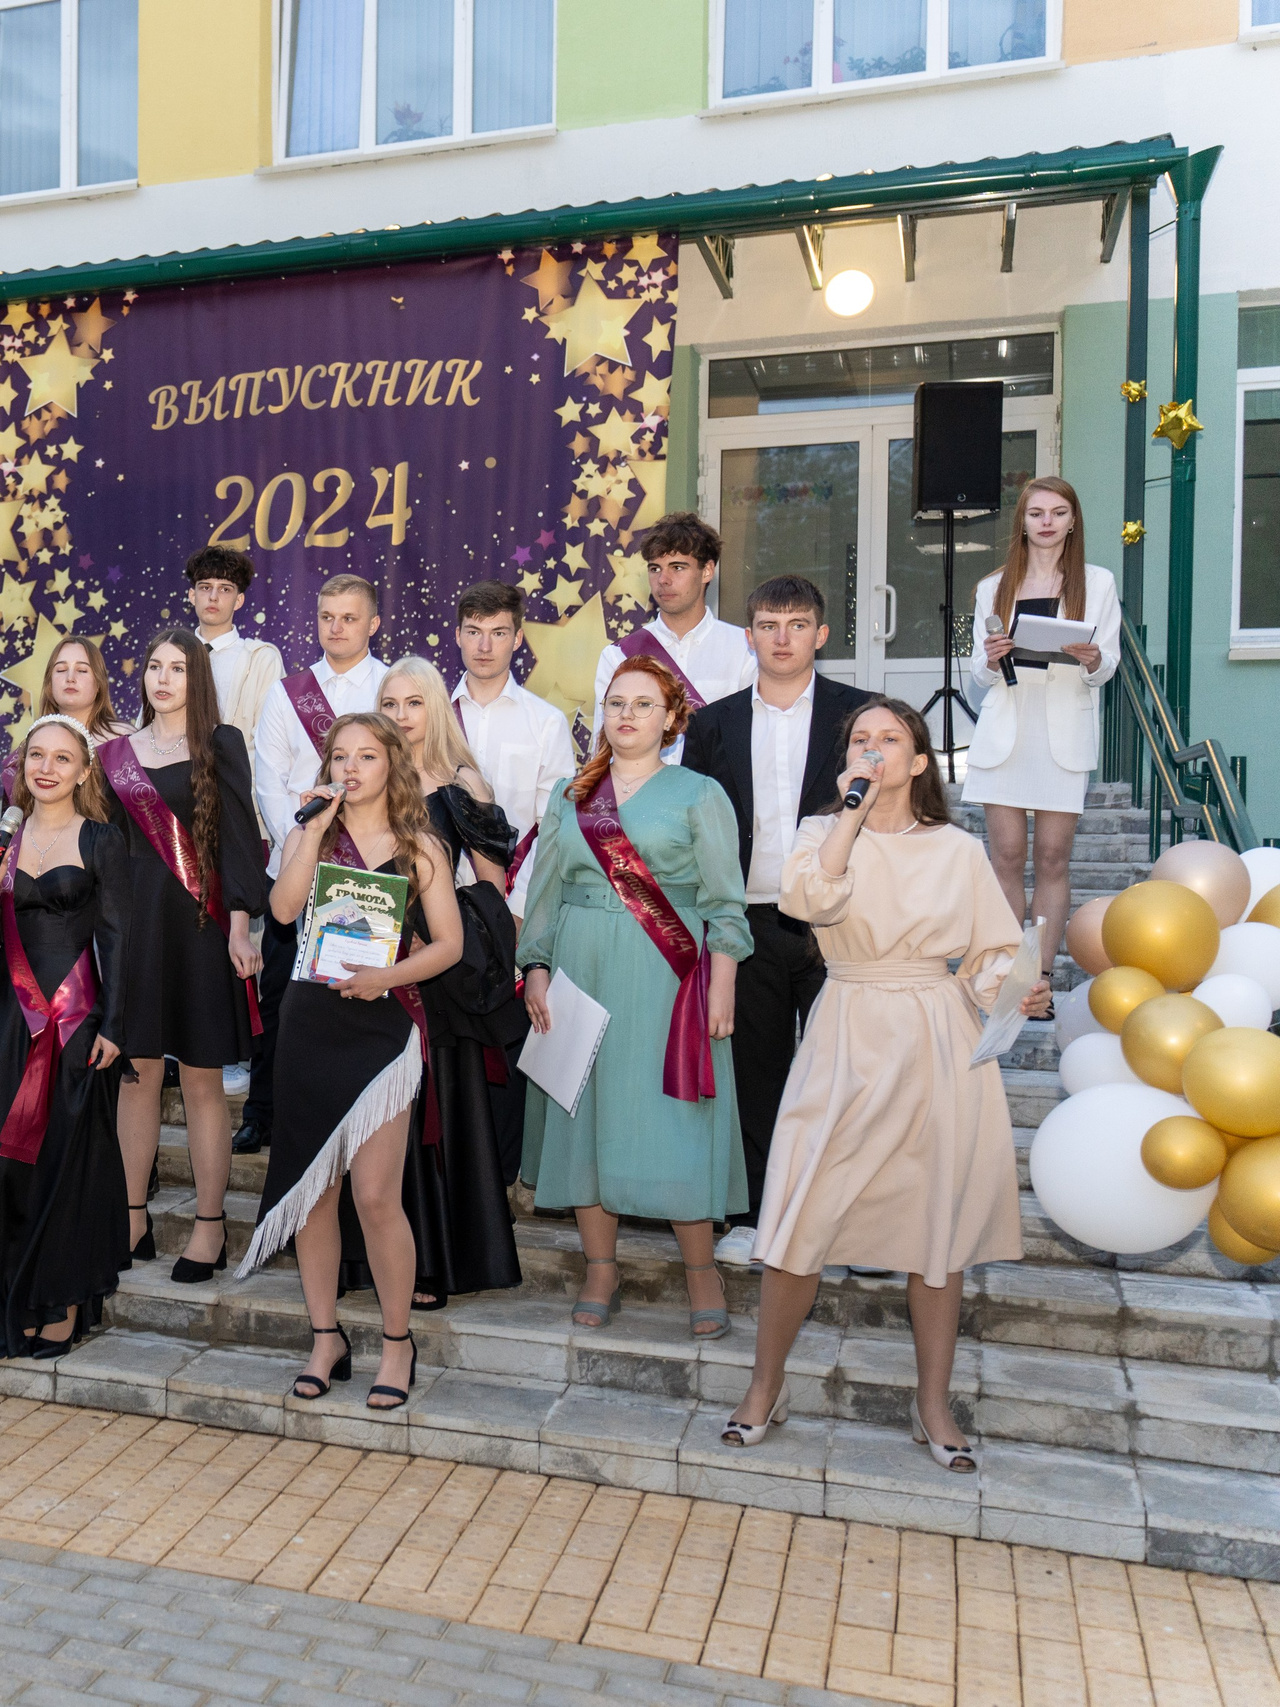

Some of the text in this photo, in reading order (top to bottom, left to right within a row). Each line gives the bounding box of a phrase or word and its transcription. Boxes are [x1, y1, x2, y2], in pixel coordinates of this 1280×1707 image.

[148, 358, 484, 431] ВЫПУСКНИК
[207, 461, 412, 552] 2024
[335, 888, 388, 906] ГРАМОТА
[653, 914, 694, 951] 2024
